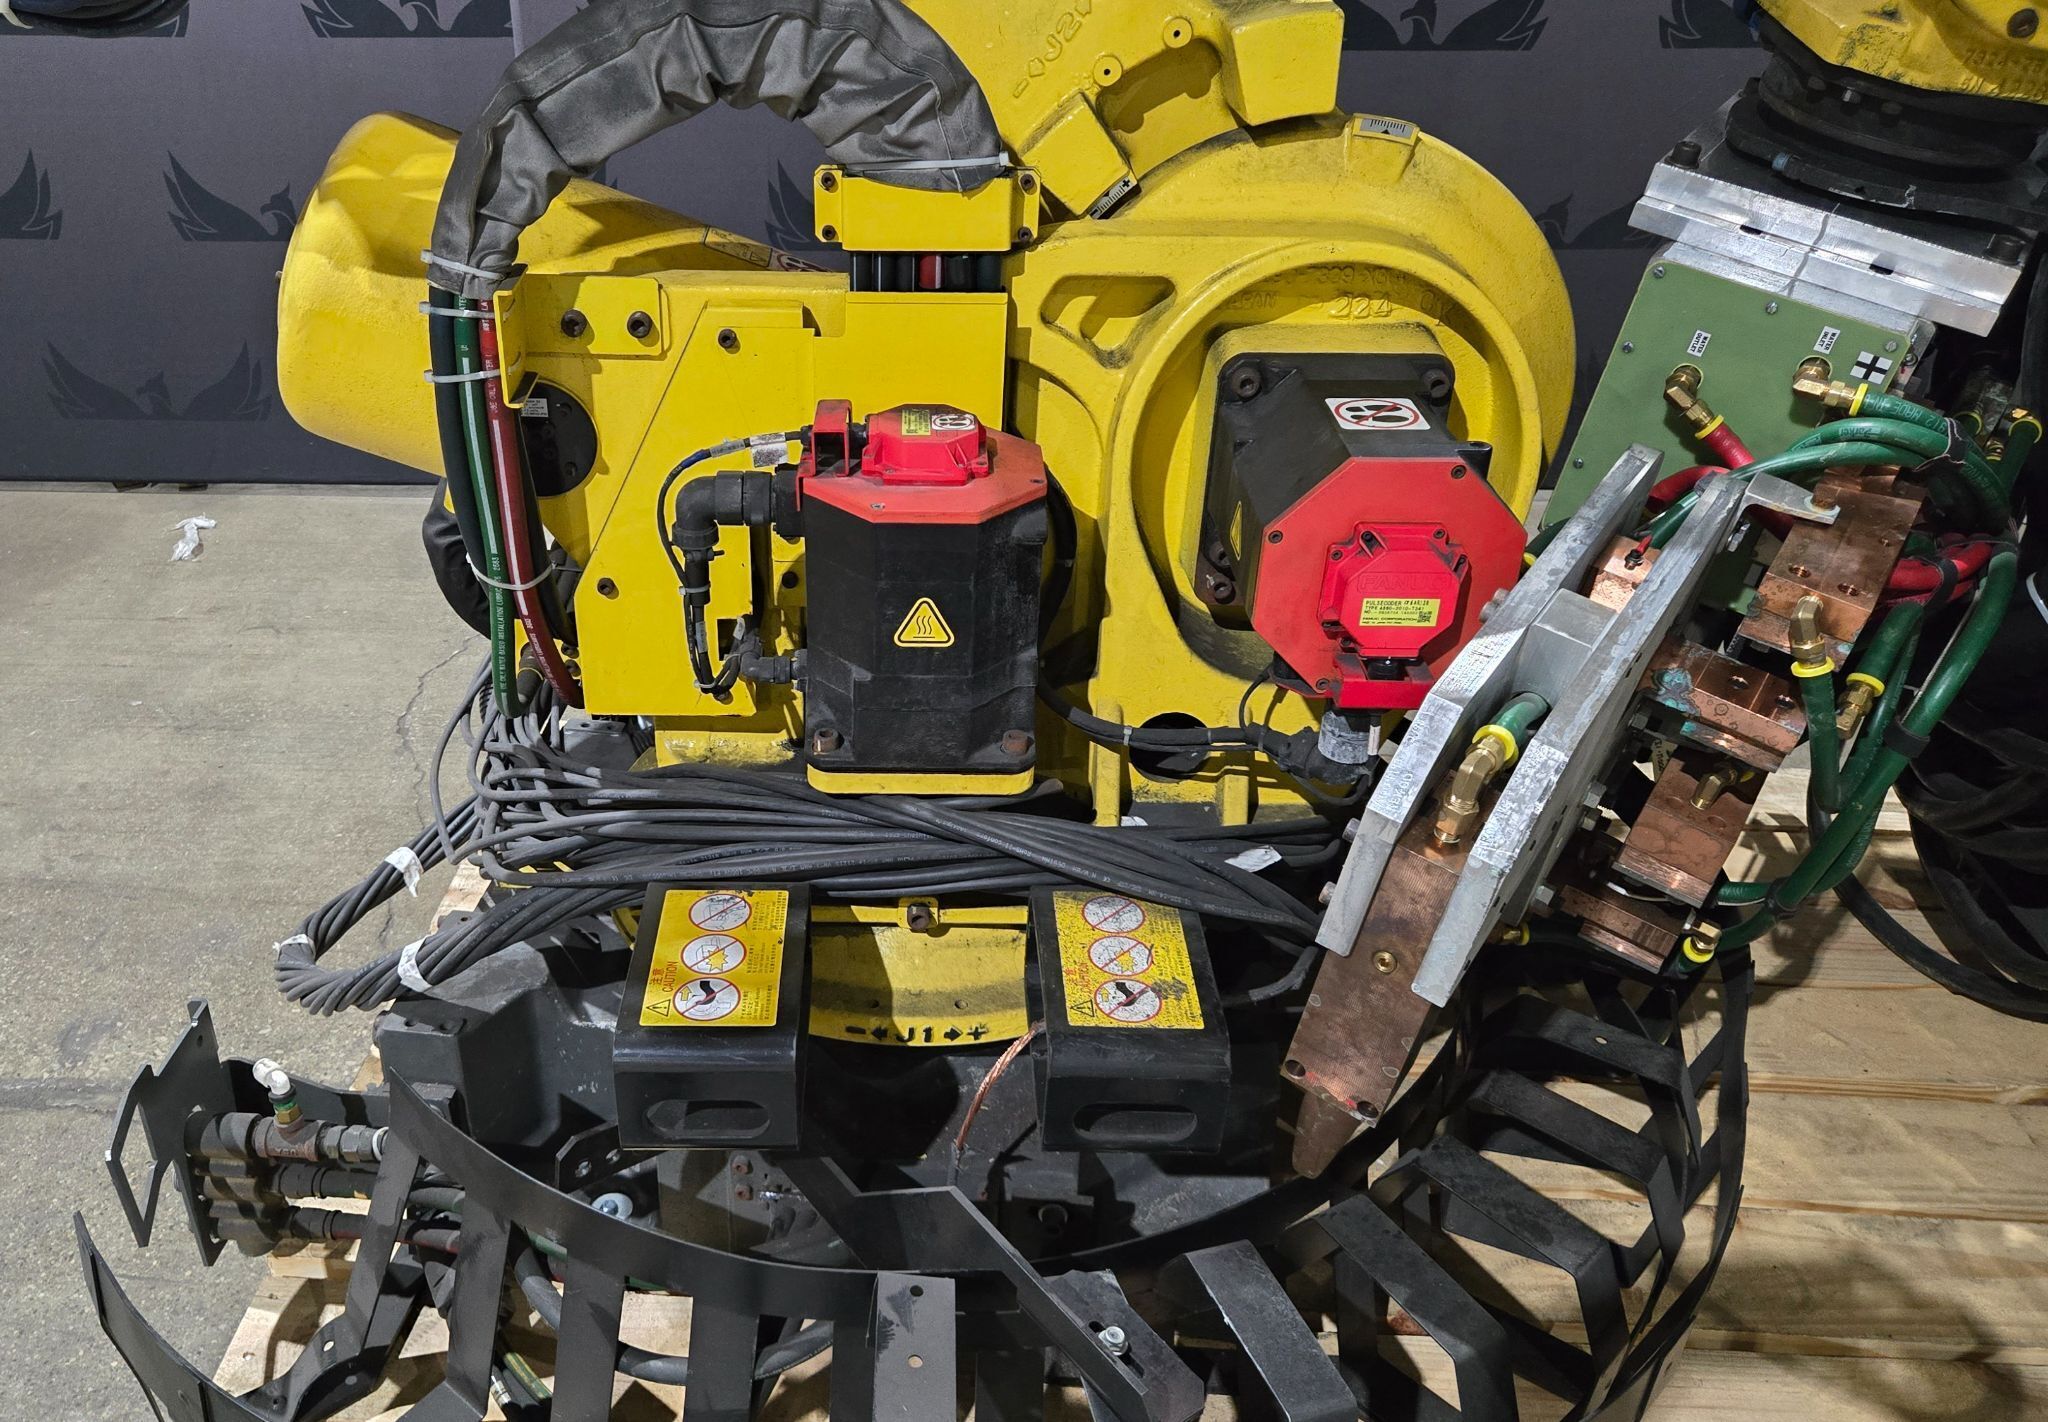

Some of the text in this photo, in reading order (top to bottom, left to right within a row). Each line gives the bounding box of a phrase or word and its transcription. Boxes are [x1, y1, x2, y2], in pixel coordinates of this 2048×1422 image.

[1044, 11, 1082, 62] J2
[1690, 332, 1703, 353] OUTLET
[1697, 335, 1709, 353] WATER
[1818, 330, 1829, 348] INLET
[1823, 331, 1837, 351] WATER
[1893, 400, 1924, 422] MADE
[1360, 573, 1448, 593] FANUC
[650, 967, 666, 986] 注意
[662, 961, 677, 993] CAUTION
[895, 1026, 933, 1043] J1
